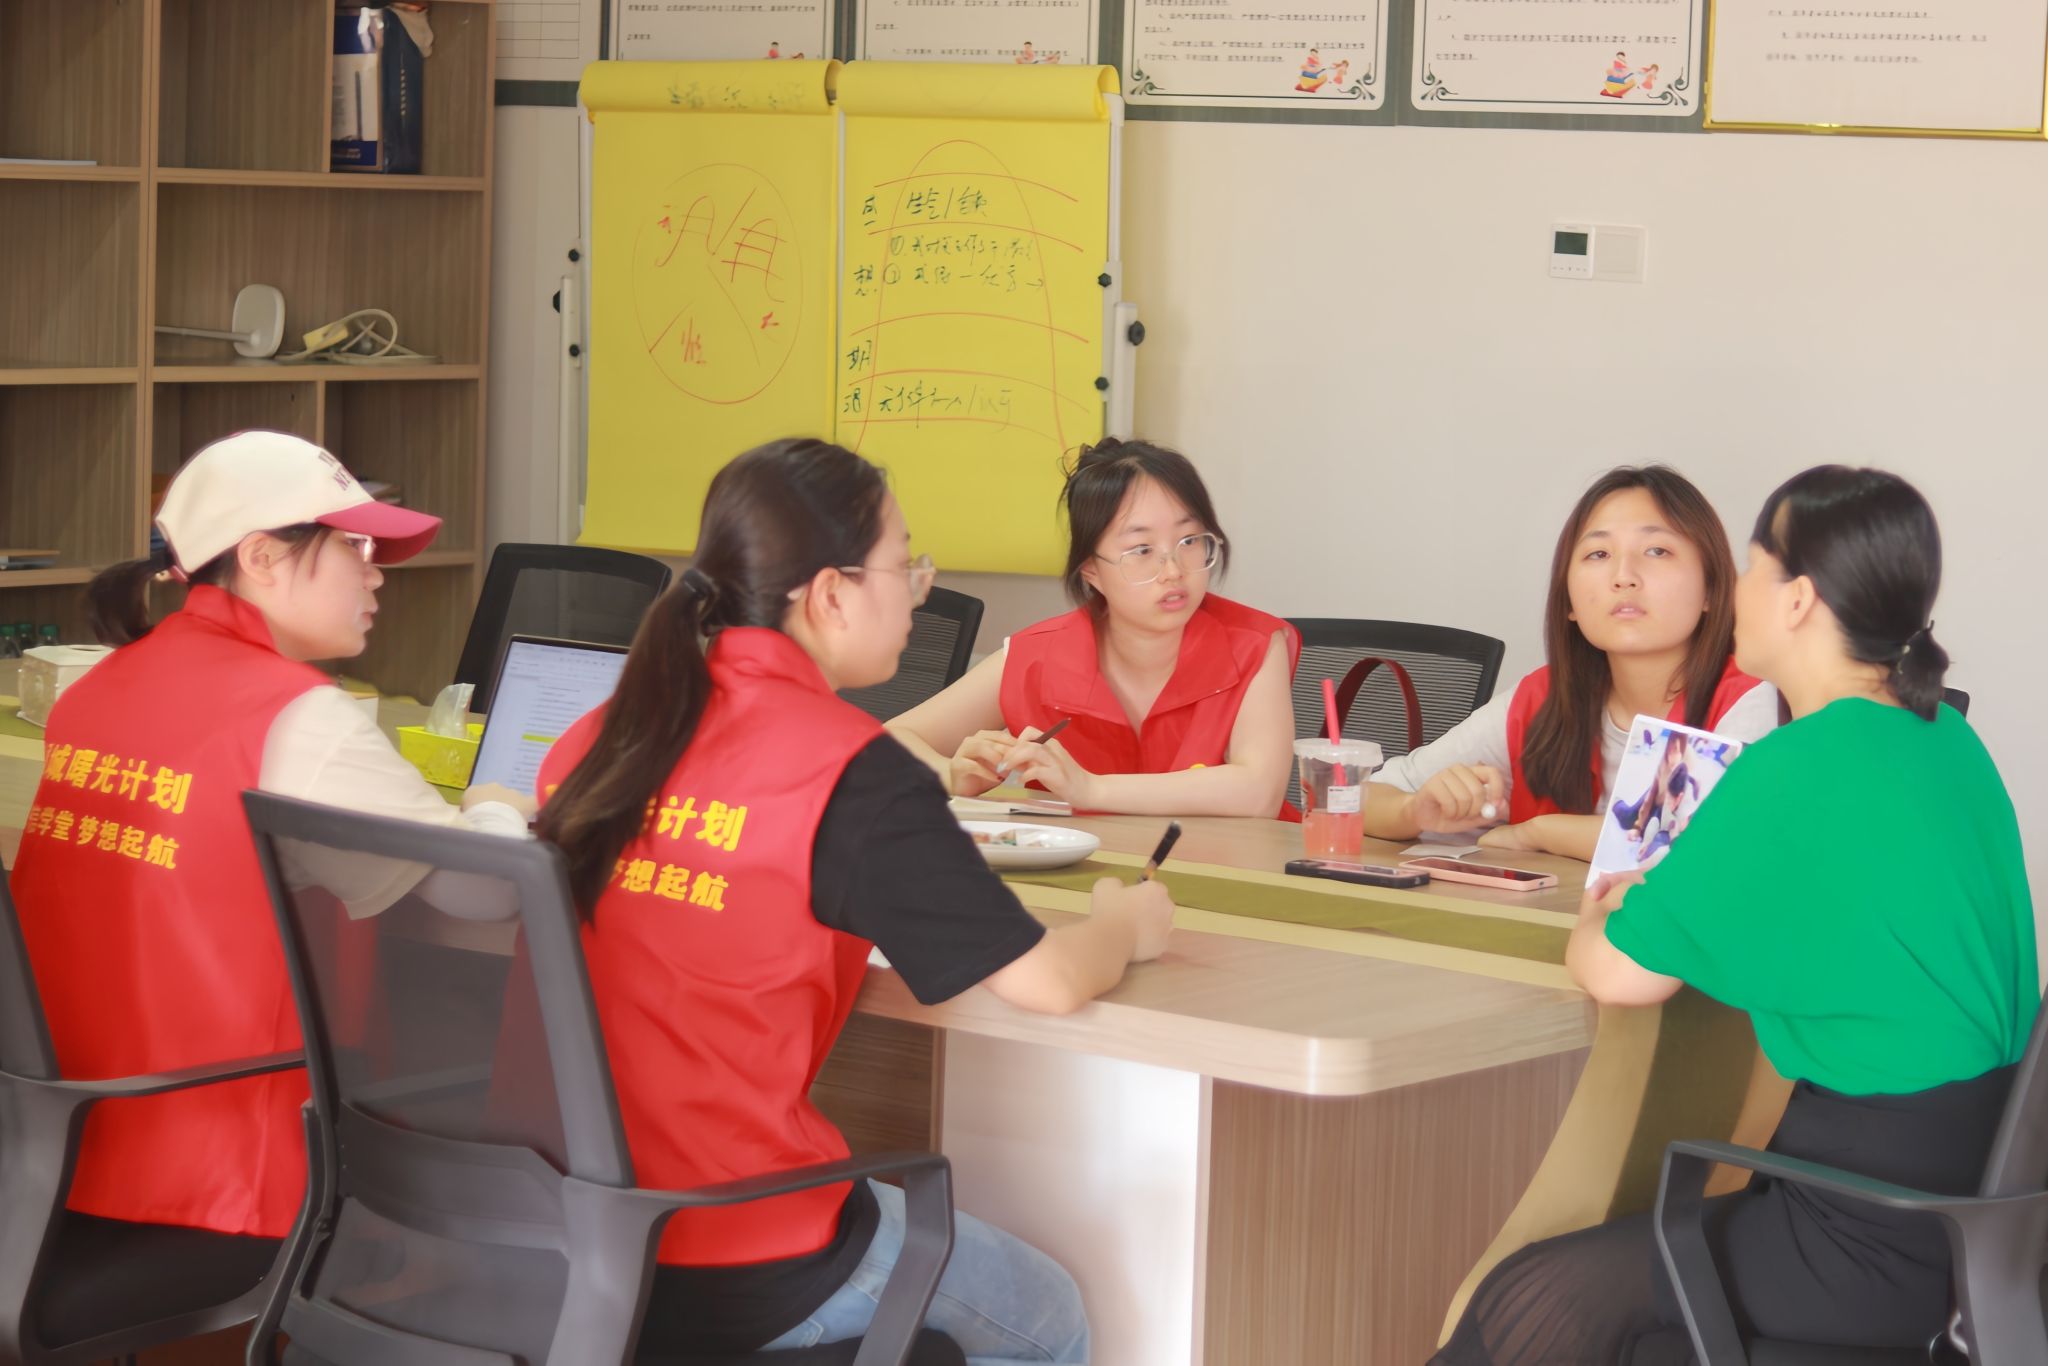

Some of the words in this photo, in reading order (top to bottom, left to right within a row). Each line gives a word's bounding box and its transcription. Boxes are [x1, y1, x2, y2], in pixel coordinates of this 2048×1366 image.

[77, 814, 180, 870] 梦想起航
[646, 795, 748, 852] 计划
